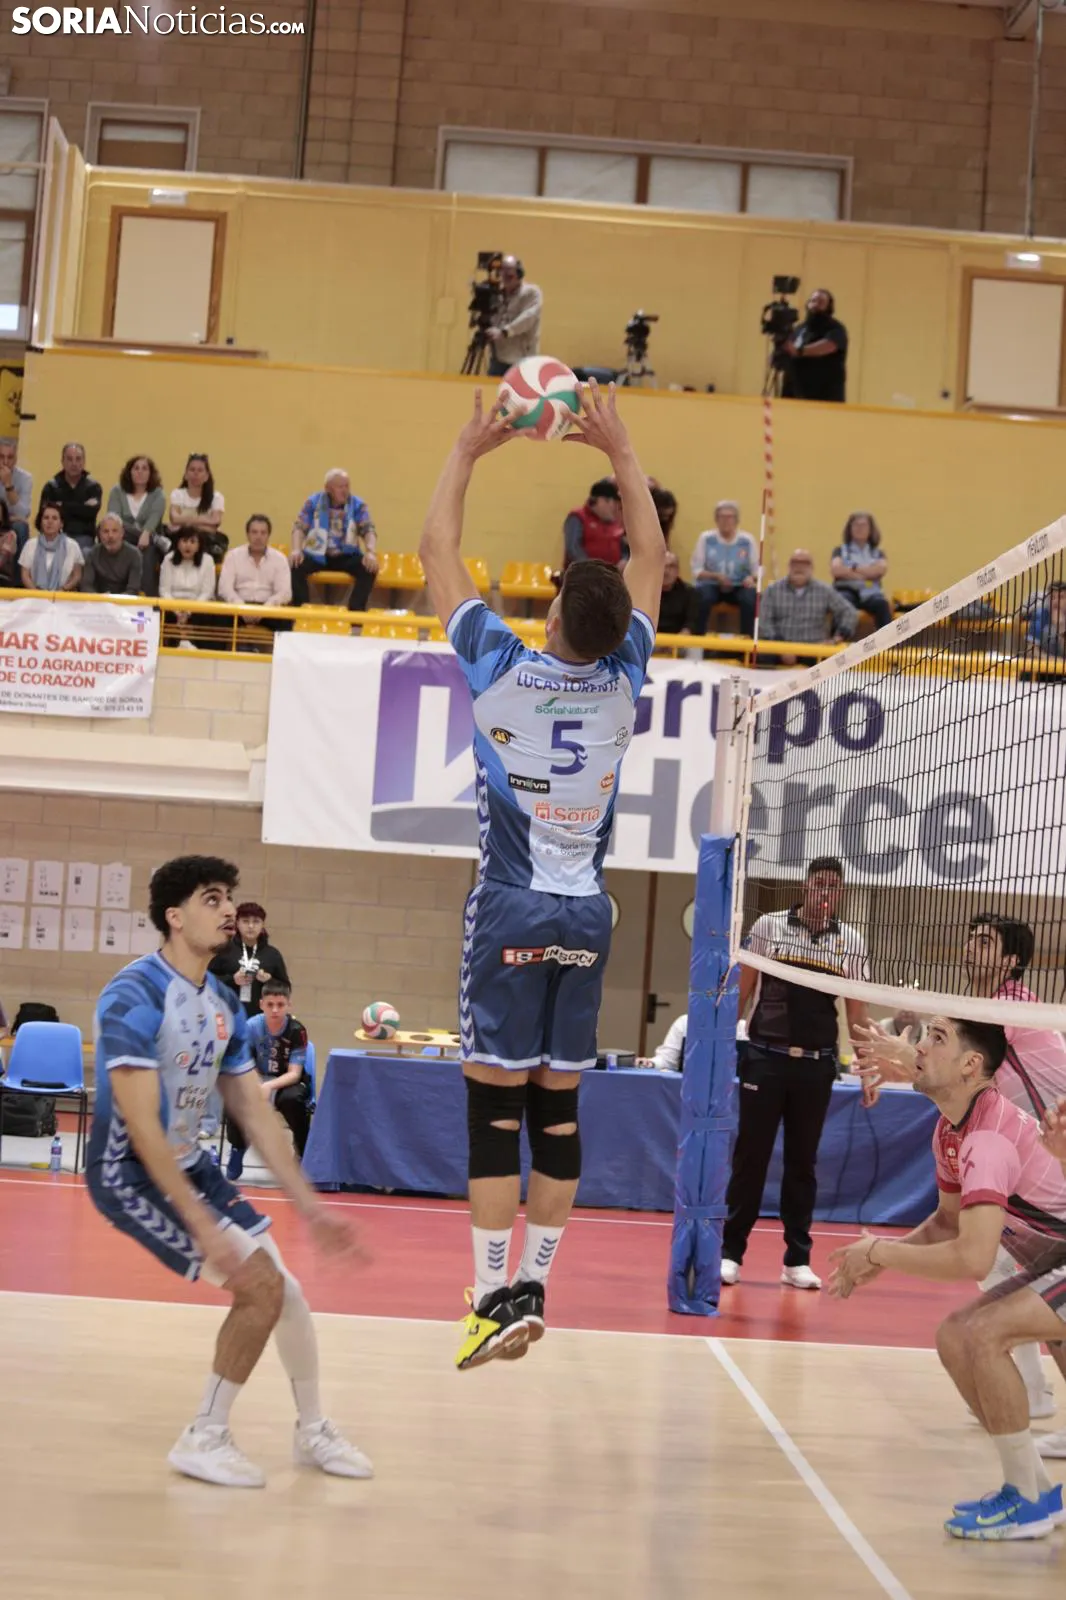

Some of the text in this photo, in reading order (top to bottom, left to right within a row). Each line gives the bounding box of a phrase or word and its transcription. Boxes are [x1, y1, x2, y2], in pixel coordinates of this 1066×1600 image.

[45, 634, 148, 657] SANGRE
[18, 656, 38, 669] LO
[20, 672, 96, 688] CORAZÓN
[517, 671, 560, 692] LUCAS
[550, 720, 588, 776] 5
[554, 807, 600, 822] Soria
[187, 1040, 215, 1075] 24
